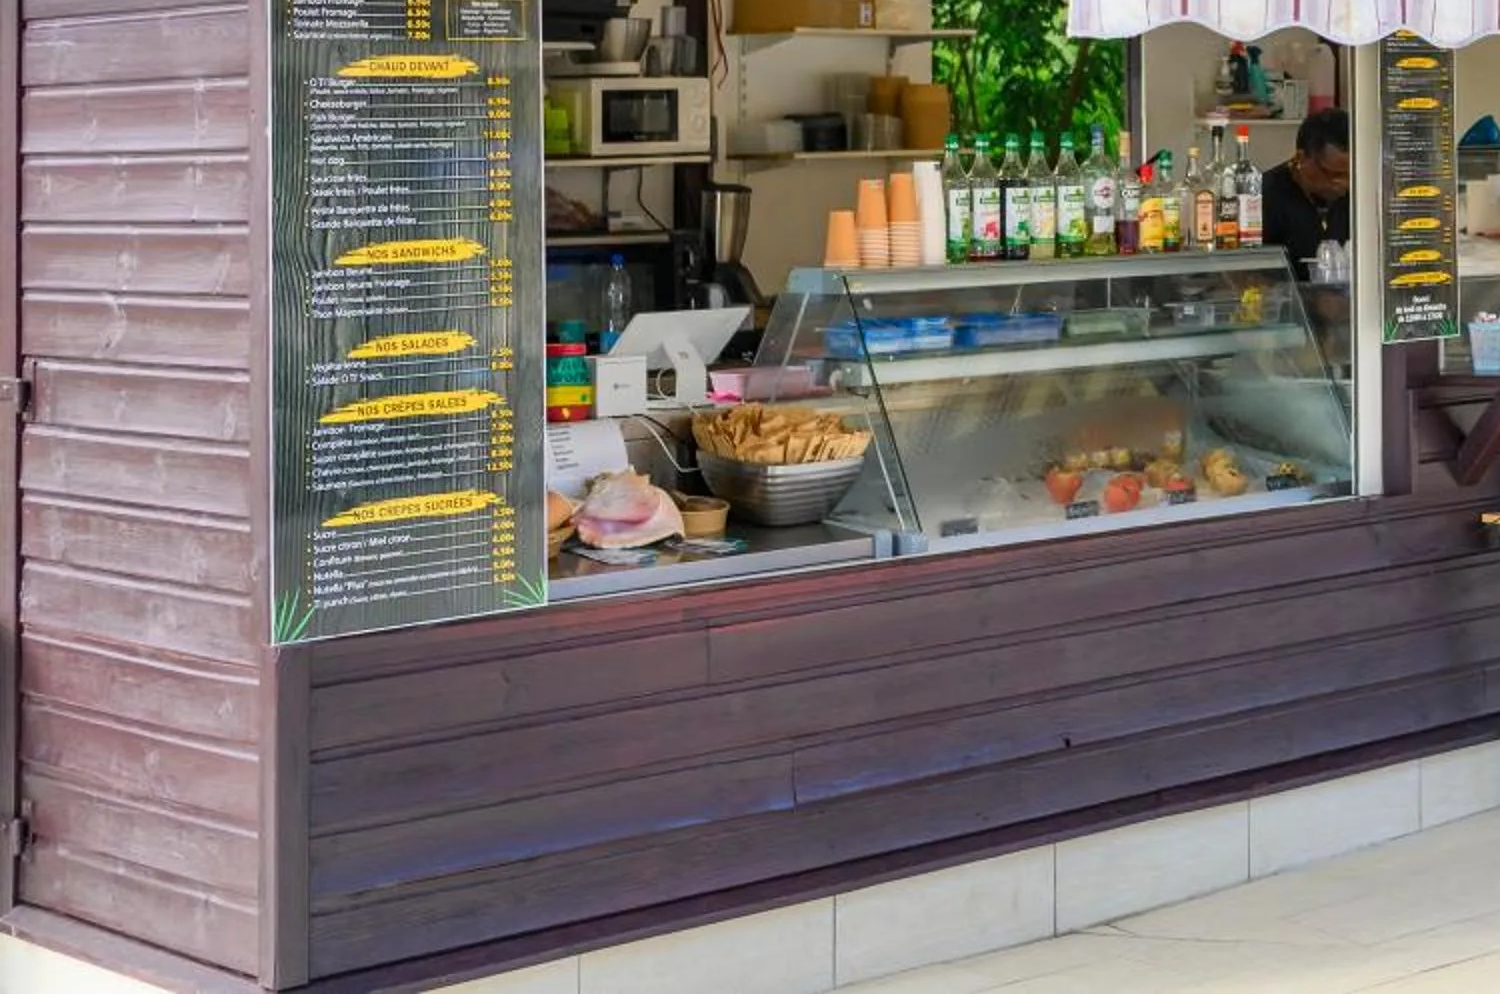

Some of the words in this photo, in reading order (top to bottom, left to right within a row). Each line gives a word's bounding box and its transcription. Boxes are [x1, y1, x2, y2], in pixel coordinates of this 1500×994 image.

[369, 62, 407, 72] CHAUD
[409, 61, 450, 72] DEVANT
[367, 249, 390, 260] NOS
[375, 342, 398, 353] NOS
[401, 337, 449, 351] SALADES
[357, 405, 380, 417] NOS
[352, 509, 375, 522] NOS
